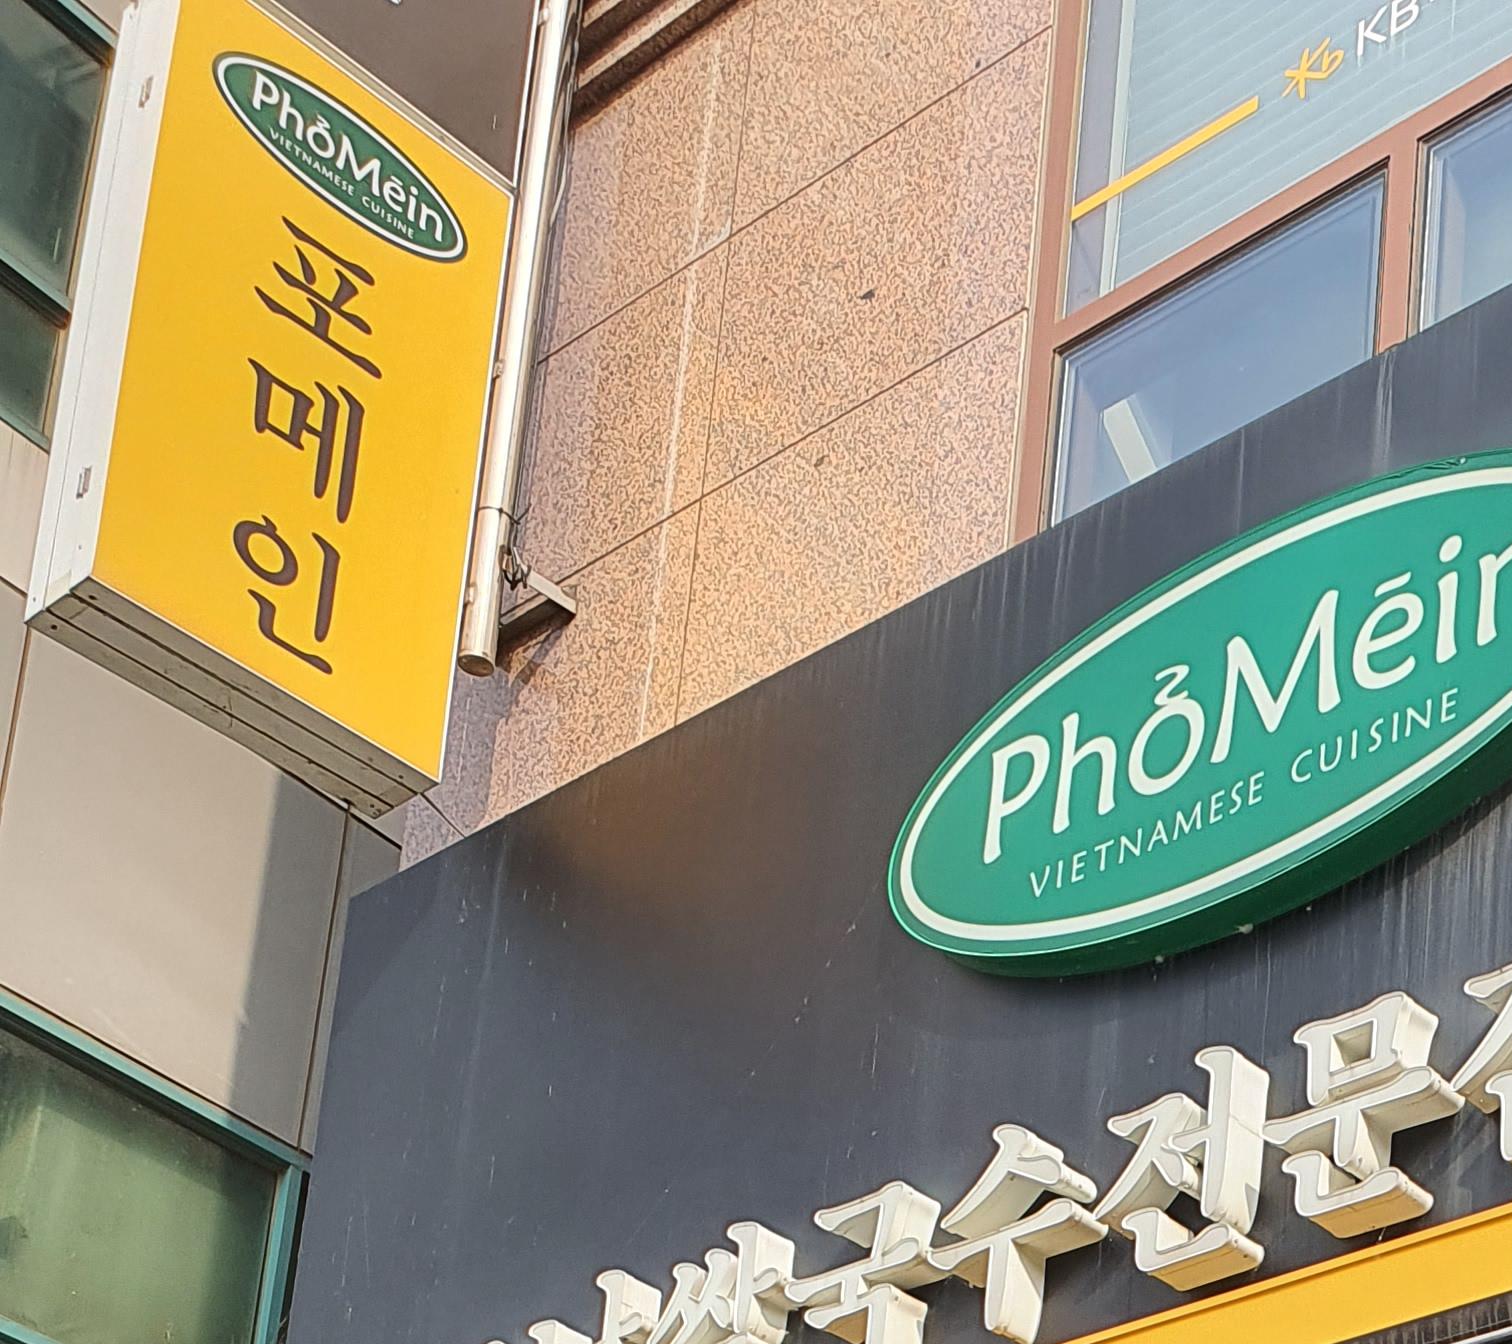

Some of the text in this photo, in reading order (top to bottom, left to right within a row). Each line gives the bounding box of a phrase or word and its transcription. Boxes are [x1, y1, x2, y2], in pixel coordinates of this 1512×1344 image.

[269, 126, 415, 241] VIETNAMESE CUISINE
[233, 214, 384, 676] 포메인
[1027, 687, 1461, 900] VIETNAMESE CUISINE
